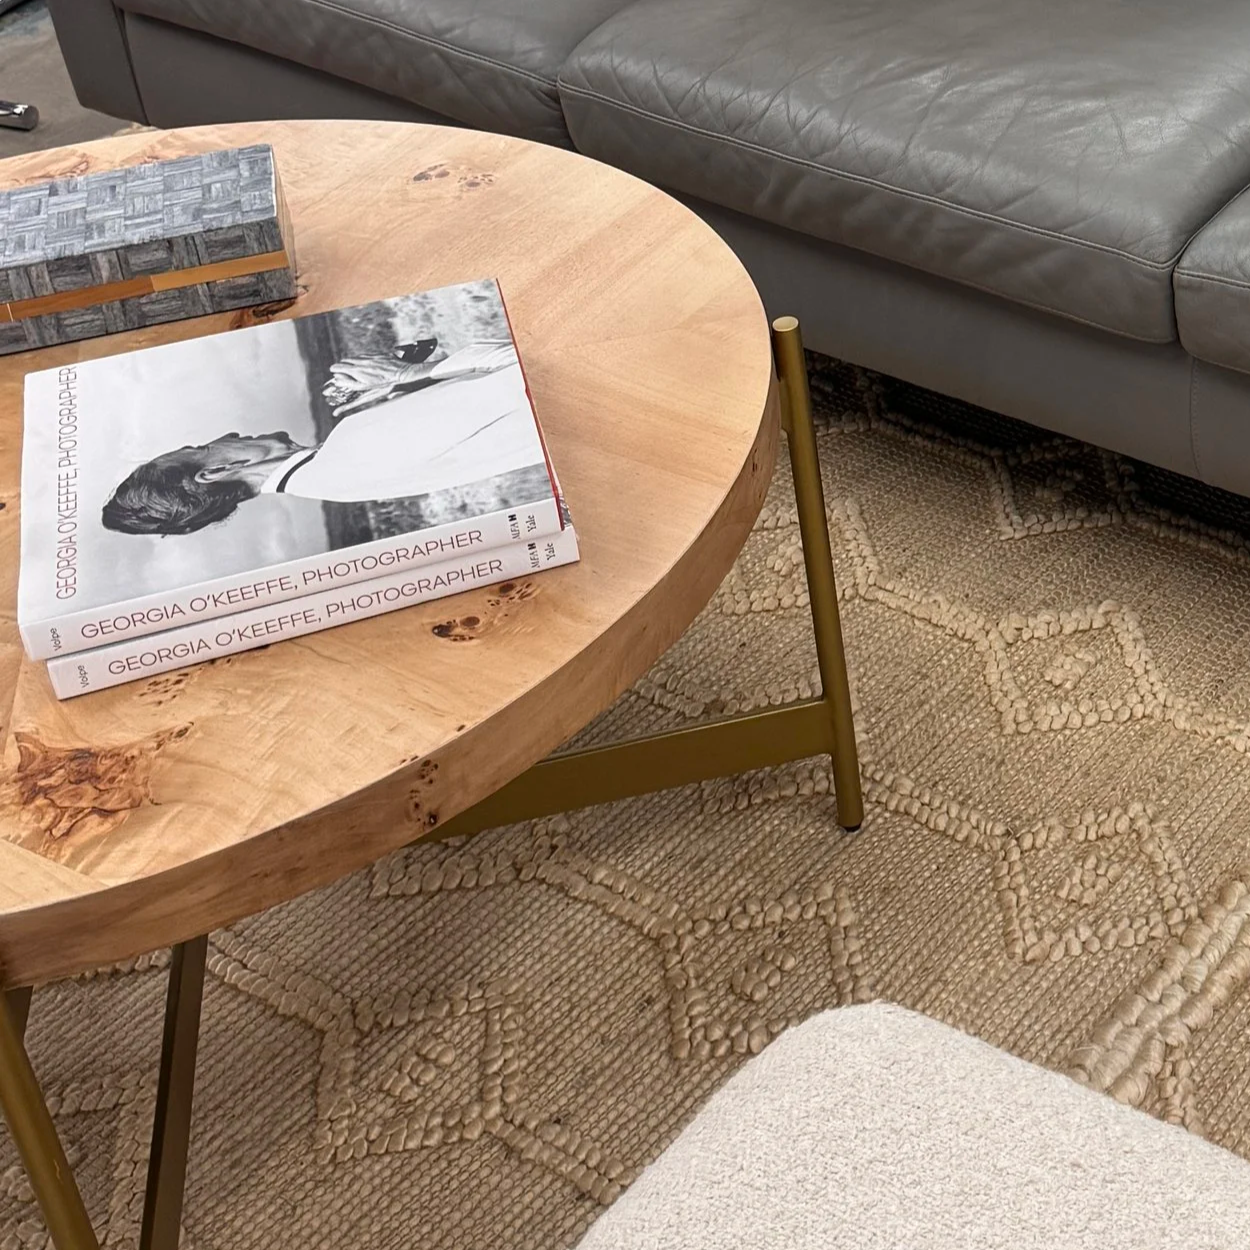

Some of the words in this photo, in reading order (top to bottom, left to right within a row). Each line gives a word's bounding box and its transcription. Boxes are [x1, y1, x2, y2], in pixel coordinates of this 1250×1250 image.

[58, 366, 77, 468] PHOTOGRAPHER
[525, 514, 537, 532] Yale
[56, 536, 77, 599] GEORGIA
[544, 542, 556, 561] Yale
[81, 603, 186, 639] GEORGIA
[190, 575, 298, 612] O'KEEFFE,
[302, 530, 483, 585] PHOTOGRAPHER
[108, 638, 211, 675] GEORGIA
[215, 608, 322, 646] O'KEEFFE,
[326, 559, 503, 618] PHOTOGRAPHER
[50, 627, 62, 651] Volpe
[77, 665, 90, 688] Volpe
